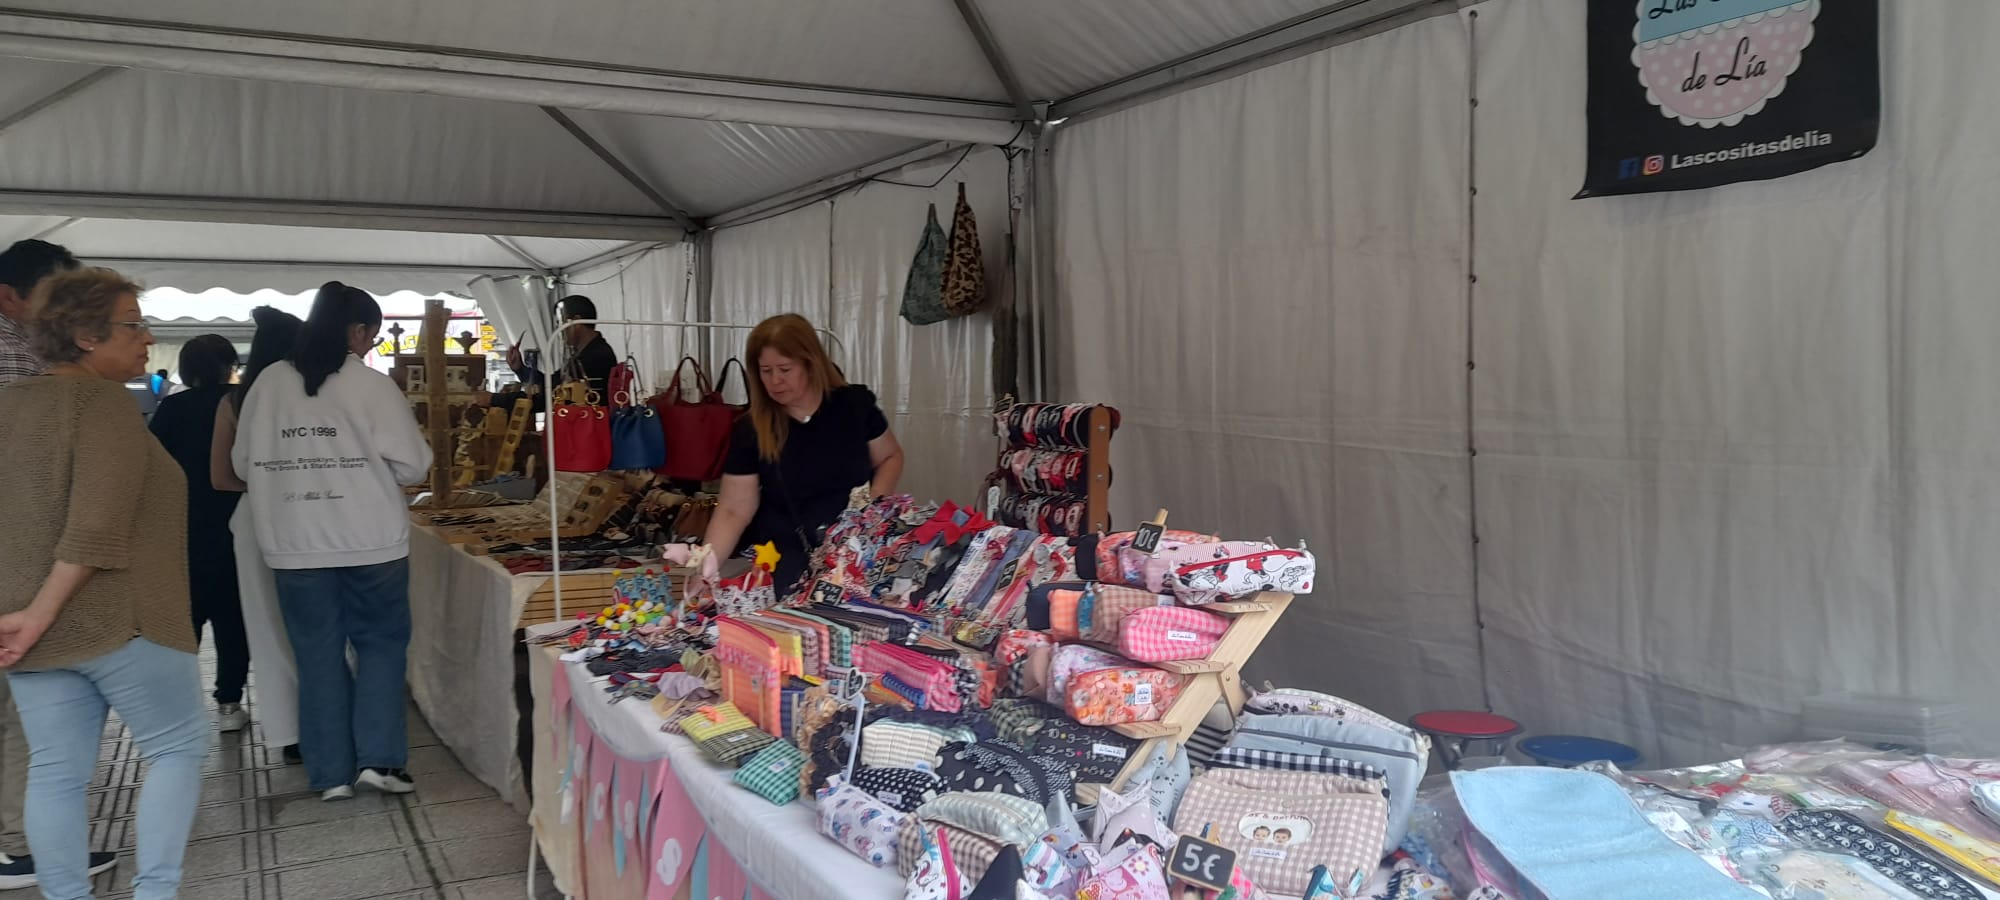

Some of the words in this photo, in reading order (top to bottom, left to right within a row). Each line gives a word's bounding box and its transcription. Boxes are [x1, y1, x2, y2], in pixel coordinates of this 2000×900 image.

[1681, 51, 1706, 93] de
[1714, 36, 1768, 87] Lía
[1671, 130, 1833, 170] Lascositasdelia
[281, 427, 307, 439] NYC
[310, 426, 337, 437] 1998
[1181, 842, 1222, 881] 5€
